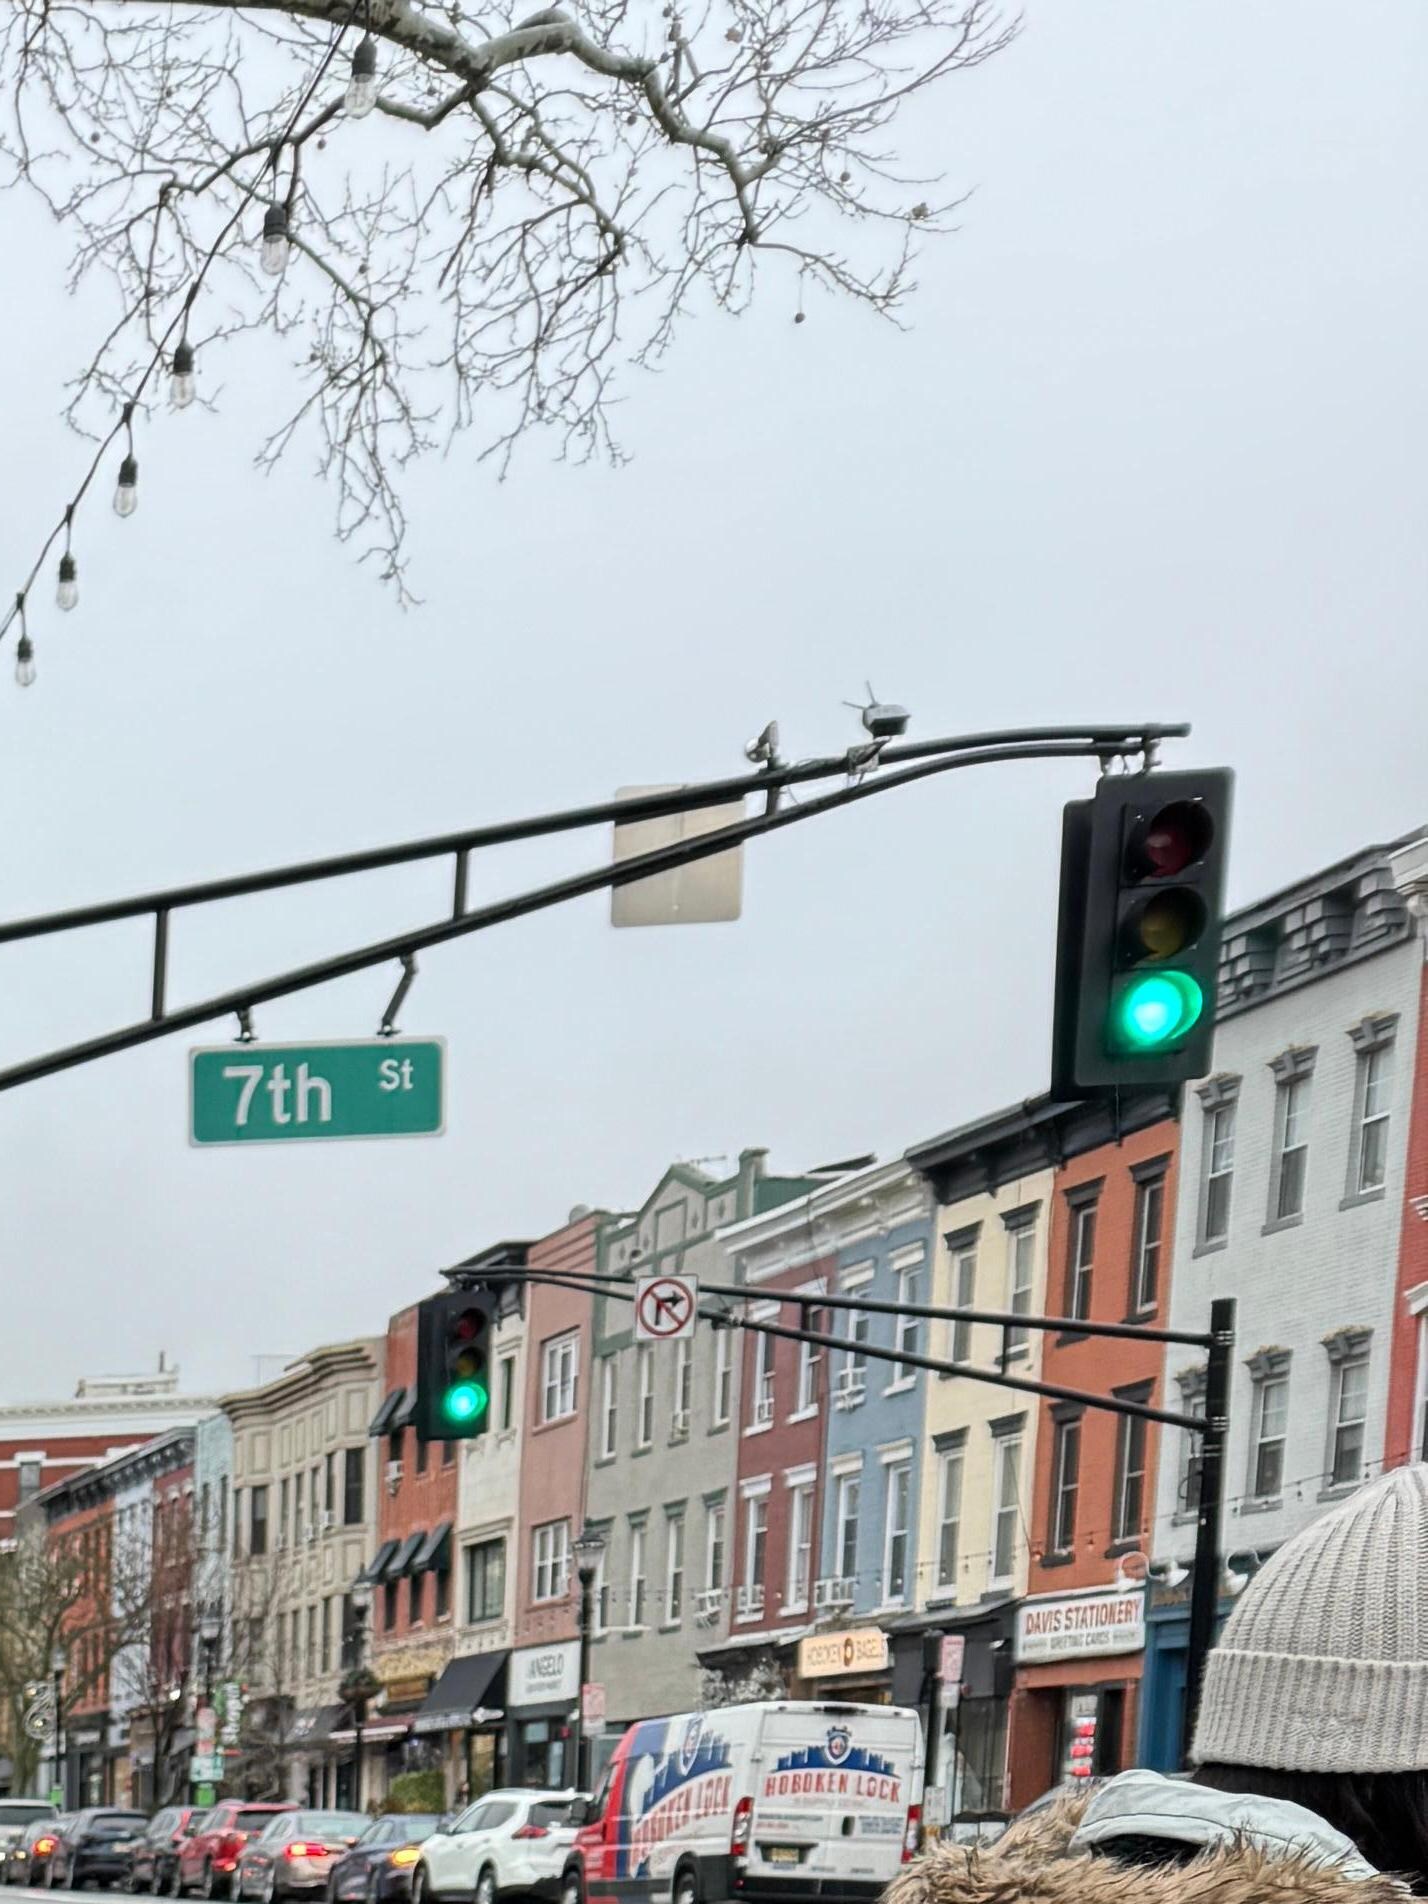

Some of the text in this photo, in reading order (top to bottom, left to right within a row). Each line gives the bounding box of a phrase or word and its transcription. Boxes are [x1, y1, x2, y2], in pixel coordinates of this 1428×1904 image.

[222, 1058, 414, 1126] 7th St
[1026, 1609, 1062, 1635] DAVIS
[1064, 1598, 1141, 1630] STATIONERY
[695, 1775, 733, 1819] LOCK
[764, 1772, 902, 1803] HOBOKEN LOCK
